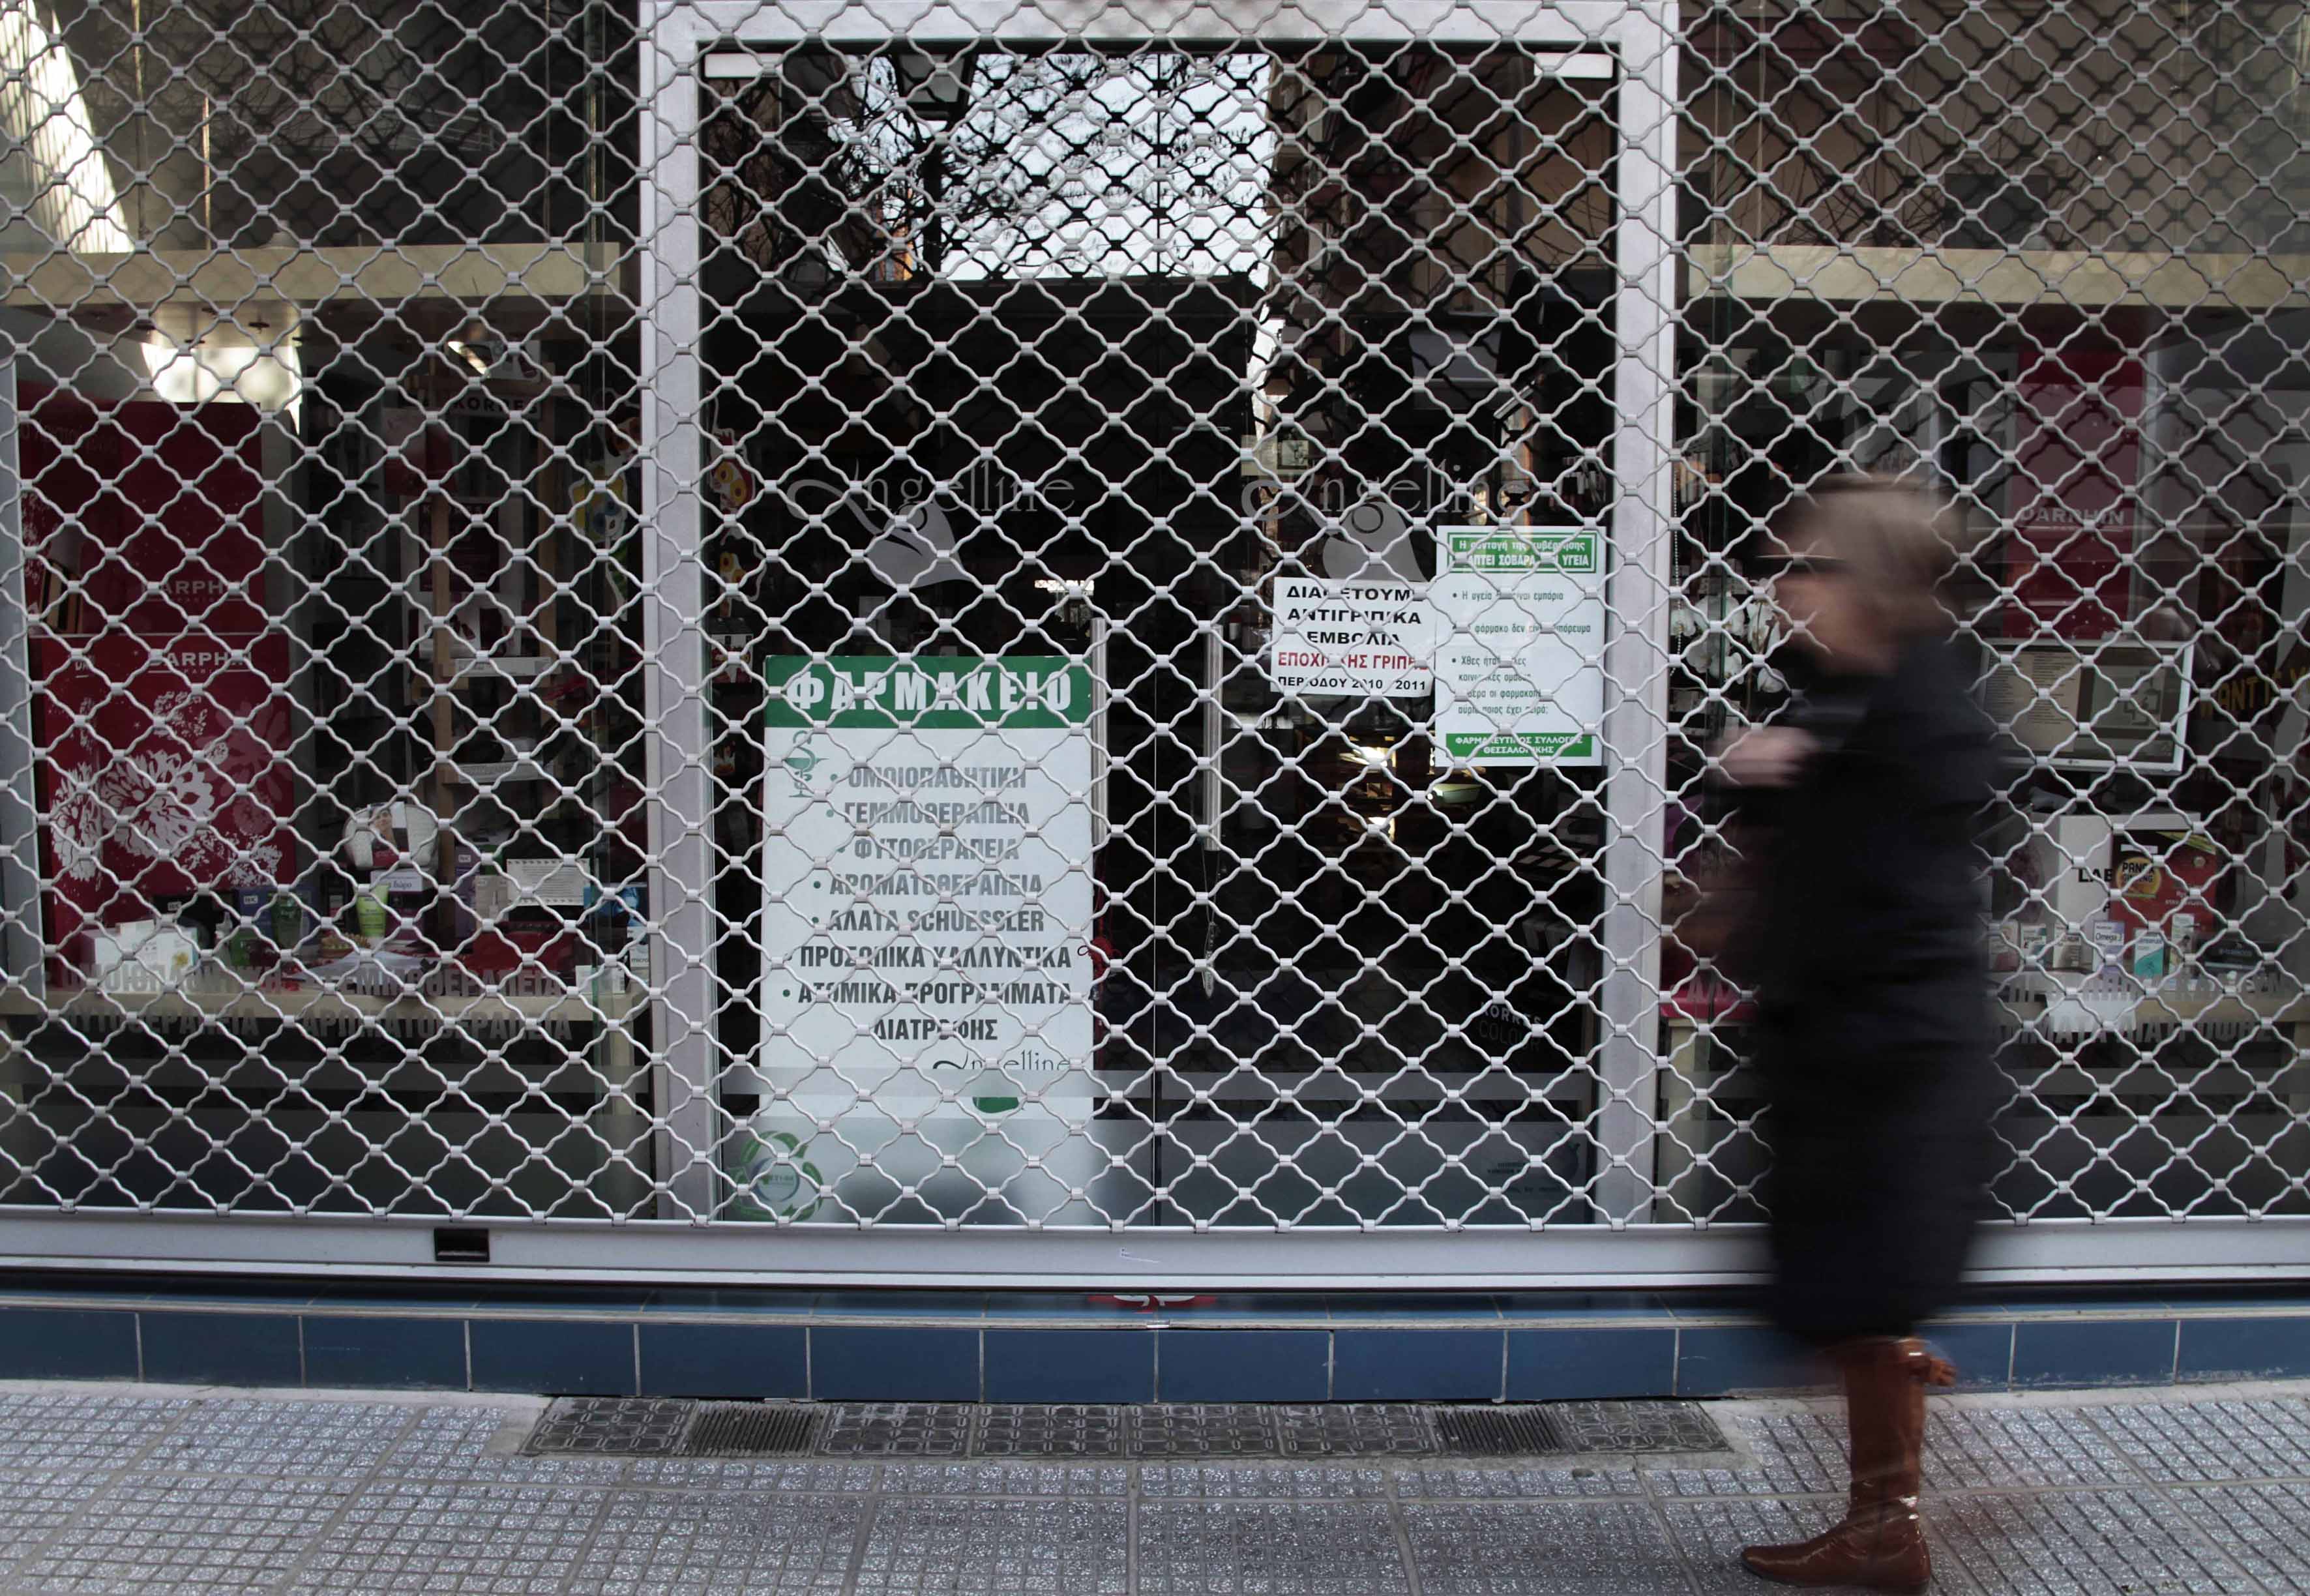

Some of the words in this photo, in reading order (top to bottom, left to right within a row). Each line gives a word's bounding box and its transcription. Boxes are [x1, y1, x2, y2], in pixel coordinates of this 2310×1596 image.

[1533, 540, 1586, 553] κυβέρησης
[1287, 585, 1425, 602] ΔΙΑΕΤΟΥΜ
[149, 651, 252, 667] ARPH
[1279, 652, 1367, 669] ΕΠΟΧΙΗΣ
[1373, 655, 1430, 670] ΓΡΙΠ
[786, 671, 1071, 711] ΦΑΡΜΑΚΕΙΟ
[1279, 677, 1348, 688] ΠΕΡΟΔΟΥ
[1396, 680, 1427, 690] 2011
[1483, 746, 1554, 754] ΘΕΣΣΑΛΟΚΗΣ
[848, 766, 1026, 788] ΟΜΟΙΟΠΑΘΗΤΙΚΗ
[844, 802, 1030, 824] ΓΕΜΜΟΘΕΡΑΠΕΙΑ
[854, 838, 1020, 860] ΦΥΤΟΘΕΡΑΠΕΙΑ
[829, 874, 1043, 896] ΑΡΟΜΑΤΟΘΕΡΑΠΕΙΑ
[828, 909, 898, 932] ΑΛΑΤΑ
[907, 909, 1044, 932] SCHUESSLER
[933, 1050, 1073, 1070] Anelline
